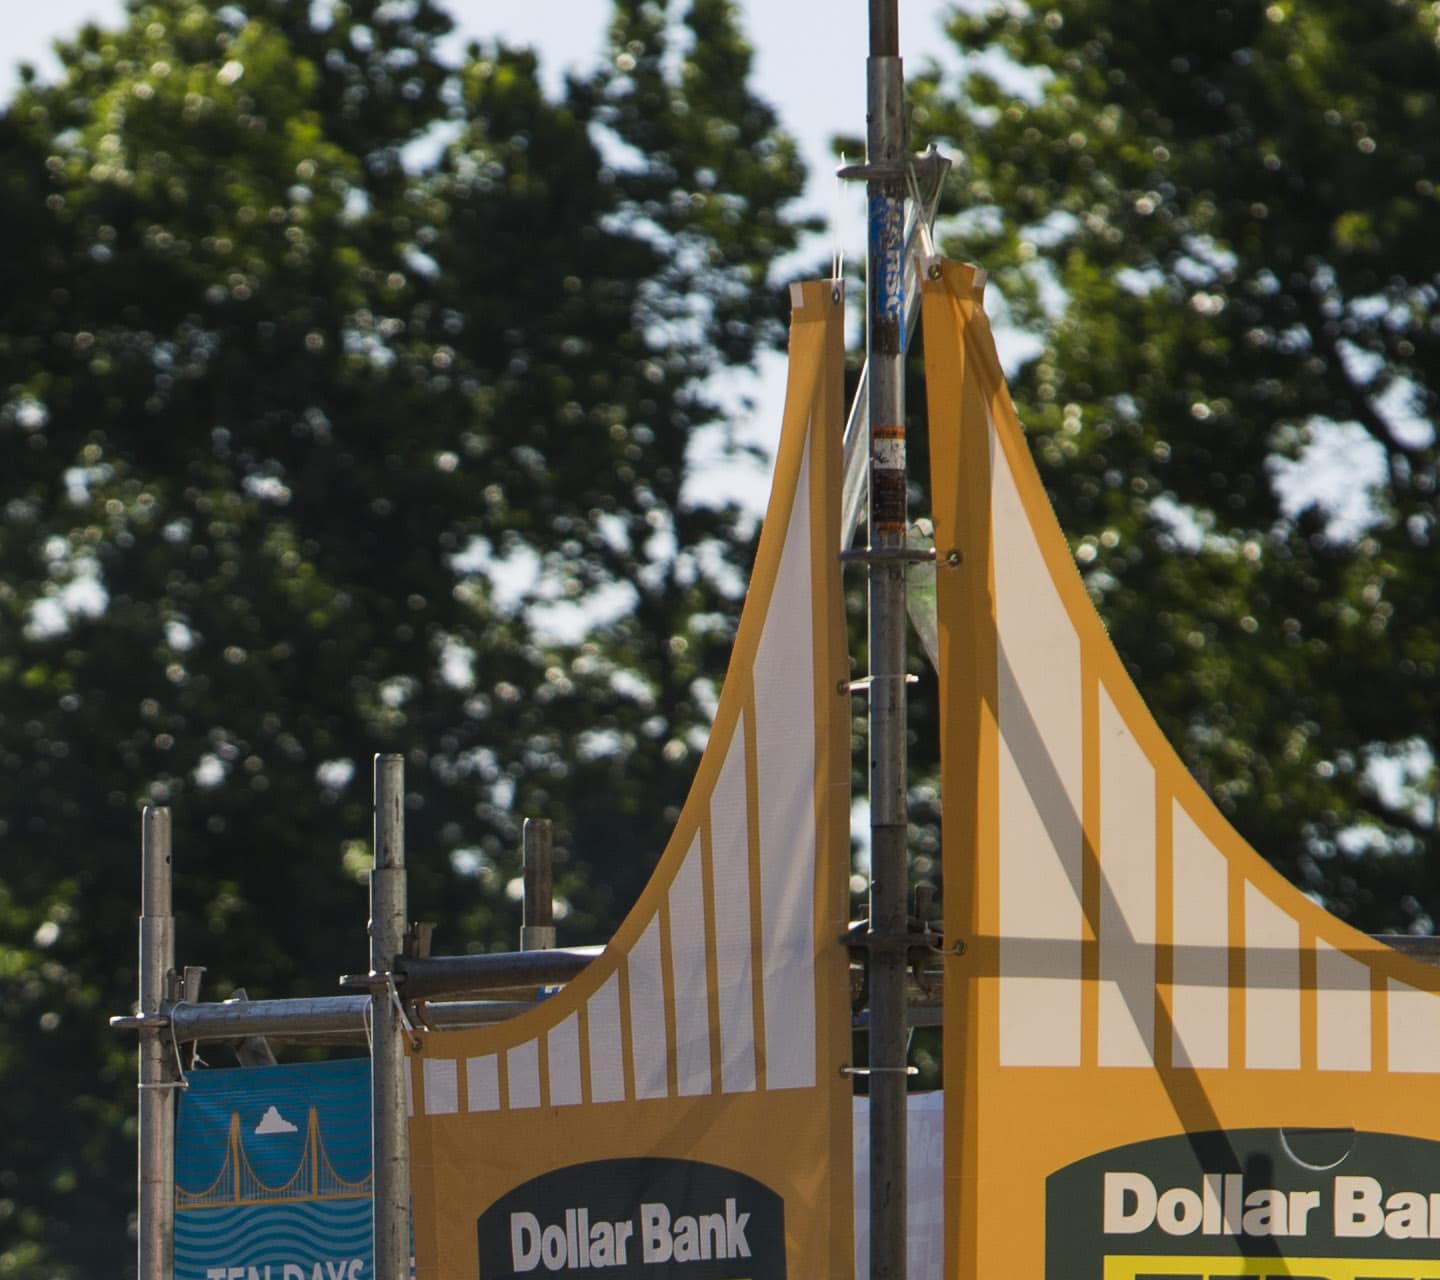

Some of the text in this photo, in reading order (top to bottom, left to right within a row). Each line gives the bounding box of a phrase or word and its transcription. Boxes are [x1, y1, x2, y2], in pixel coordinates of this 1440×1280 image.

[511, 1199, 752, 1273] Dollar Bank
[1103, 1171, 1320, 1237] Dollar
